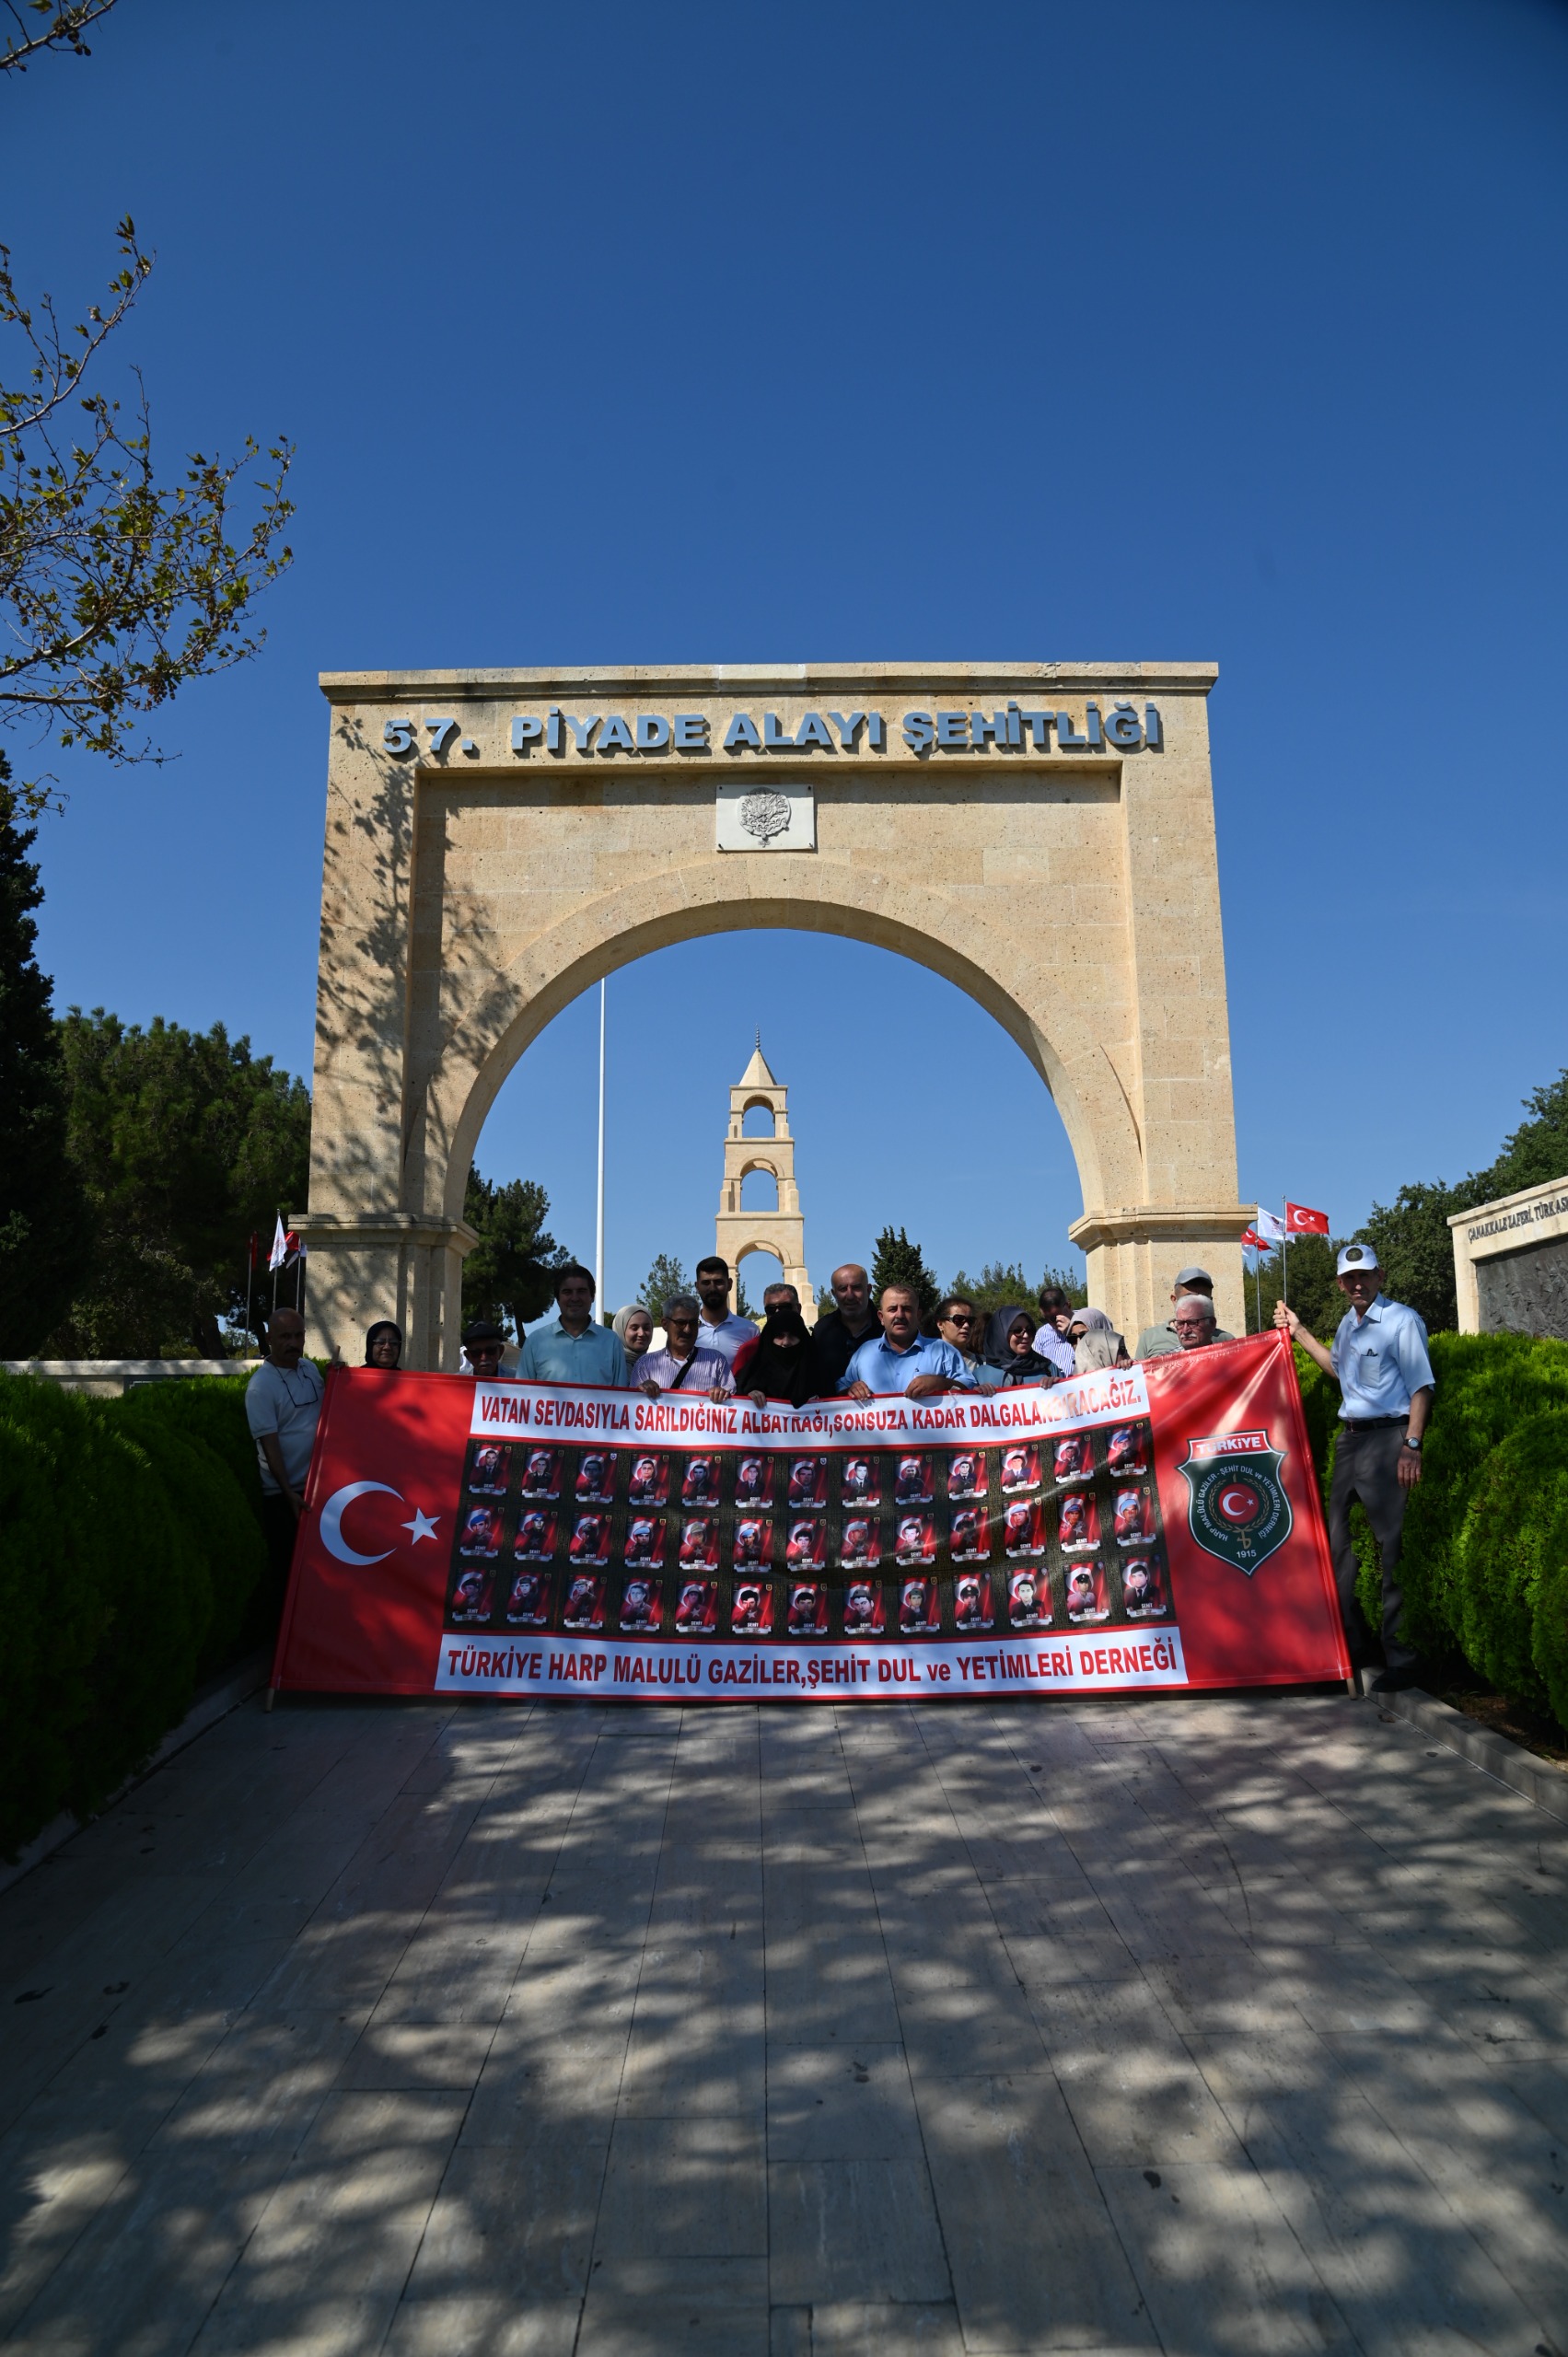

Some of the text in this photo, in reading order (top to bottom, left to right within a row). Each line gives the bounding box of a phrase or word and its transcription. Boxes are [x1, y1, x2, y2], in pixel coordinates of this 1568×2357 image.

[383, 701, 1158, 754] 57. PİYADE ALAYI ŞEHİTLİĞİ
[482, 1395, 528, 1424] VATAN
[534, 1399, 630, 1431] SEVDASIYLA
[912, 1407, 965, 1430] KADAR
[970, 1376, 1142, 1428] DALGALANDIRACAĞIZ.
[1219, 1464, 1238, 1476] ŞEHİT
[1240, 1466, 1253, 1476] DUL
[1254, 1471, 1262, 1480] ve
[1199, 1473, 1217, 1498] GAZİLER
[1261, 1476, 1282, 1512] YETİMLERİ
[1209, 1527, 1228, 1541] HARP
[1258, 1513, 1279, 1539] DERNEĞİ
[1237, 1550, 1257, 1559] 1915
[448, 1645, 542, 1679] TÜRKİYE
[548, 1653, 607, 1682] HARP
[613, 1654, 701, 1684] MALULÜ
[877, 1658, 921, 1683] DUL
[926, 1662, 950, 1682] ve
[956, 1645, 1074, 1680] YETİMLERİ
[1079, 1636, 1178, 1676] DERNEĞİ
